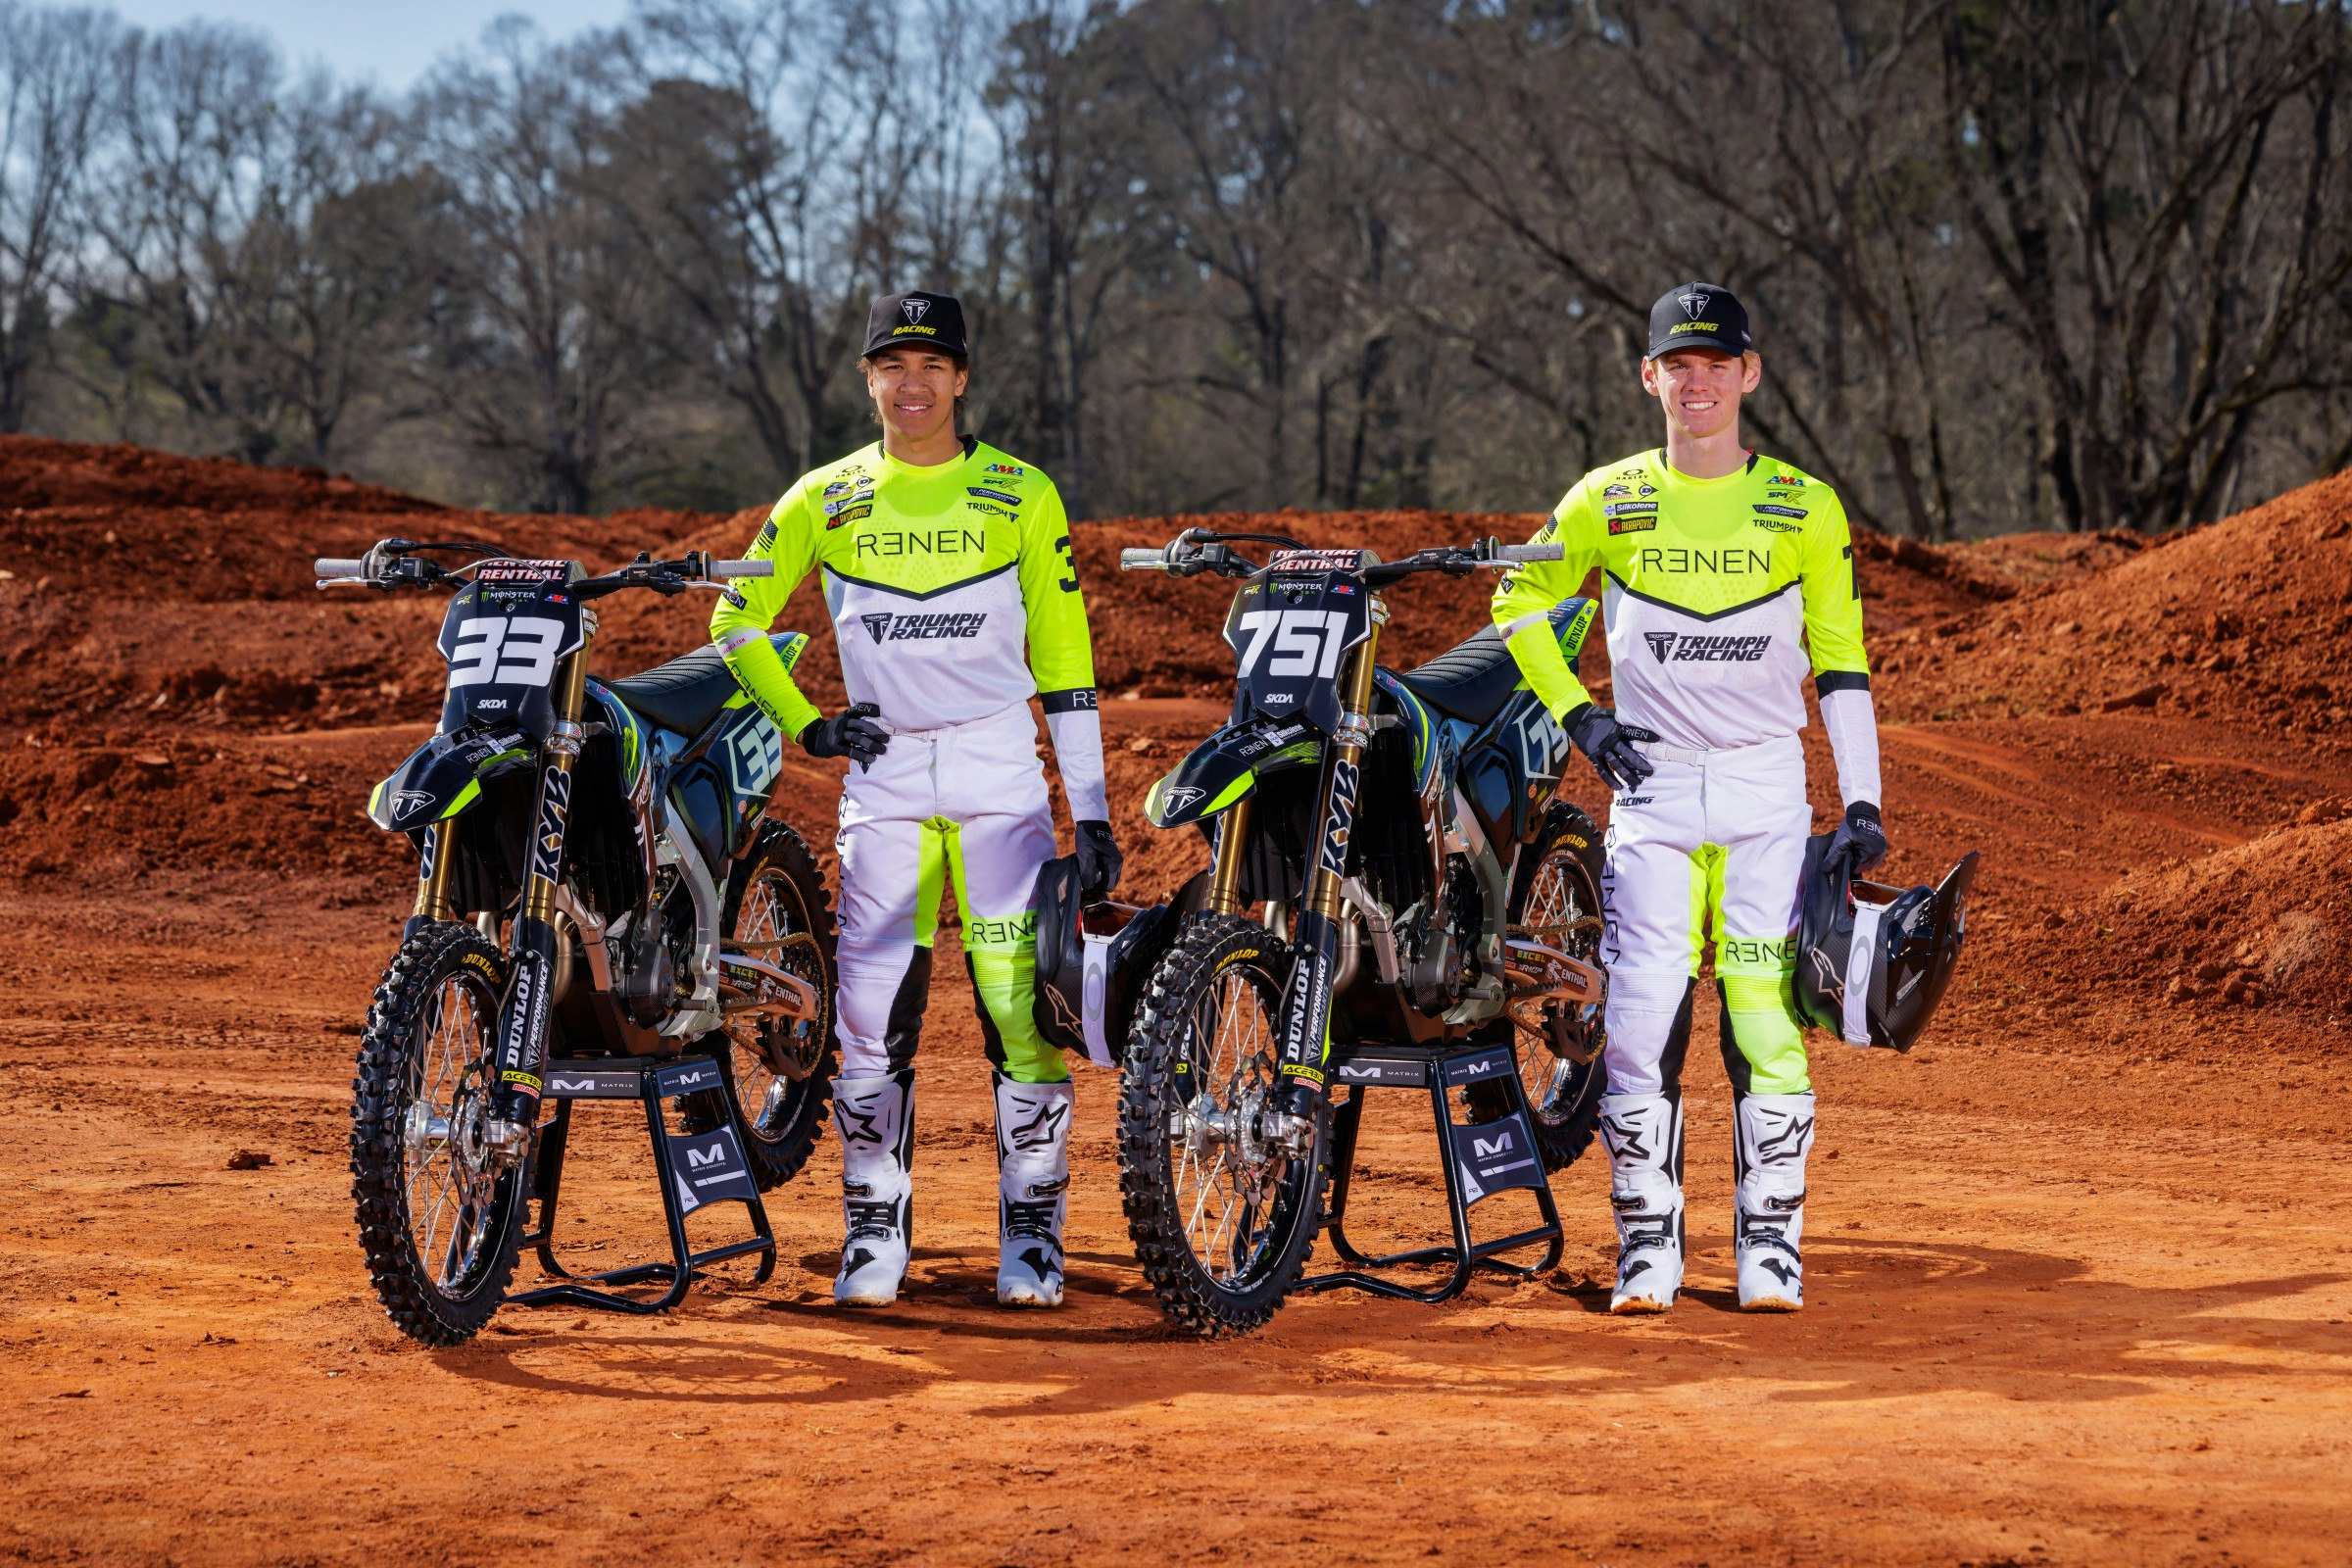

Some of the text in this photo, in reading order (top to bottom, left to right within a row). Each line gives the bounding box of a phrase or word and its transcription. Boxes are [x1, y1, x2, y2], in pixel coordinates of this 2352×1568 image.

[892, 325, 938, 336] RACING
[1669, 321, 1719, 335] RACING
[983, 463, 1024, 476] AMA
[1766, 476, 1804, 487] AMA
[978, 488, 1020, 503] PERFORMANCE
[966, 502, 1008, 517] TRIUMPH
[1616, 502, 1657, 513] Silkolene
[1764, 505, 1806, 516] PERFORMANCE
[1752, 519, 1796, 533] TRIUMPH
[1272, 558, 1357, 571] RENTHAL
[477, 568, 564, 581] RENTHAL
[1278, 582, 1323, 591] MONSTER
[490, 590, 536, 599] MONSTER
[895, 612, 988, 626] TRIUMPH
[888, 625, 980, 641] RACING
[1565, 615, 1589, 652] DUNLOP
[1236, 610, 1349, 679] 751
[1677, 635, 1772, 649] TRIUMPH
[449, 616, 565, 689] 33
[1671, 649, 1766, 662] RACING
[476, 699, 508, 710] SKDA
[1263, 693, 1295, 704] SKDA
[737, 714, 783, 792] 33
[396, 791, 426, 800] TRIUMPH
[531, 764, 571, 887] KYB
[1319, 759, 1359, 881] KYB
[1551, 833, 1589, 851] DUNLOP
[1214, 948, 1260, 973] DUNLOP
[1516, 949, 1546, 963] EXCEL
[465, 953, 502, 985] DUNLOP
[729, 964, 760, 979] EXCEL
[530, 963, 549, 1048] PERFORMANCE
[1309, 955, 1328, 1042] PERFORMANCE
[506, 964, 534, 1069] DUNLOP
[1286, 958, 1311, 1062] DUNLOP
